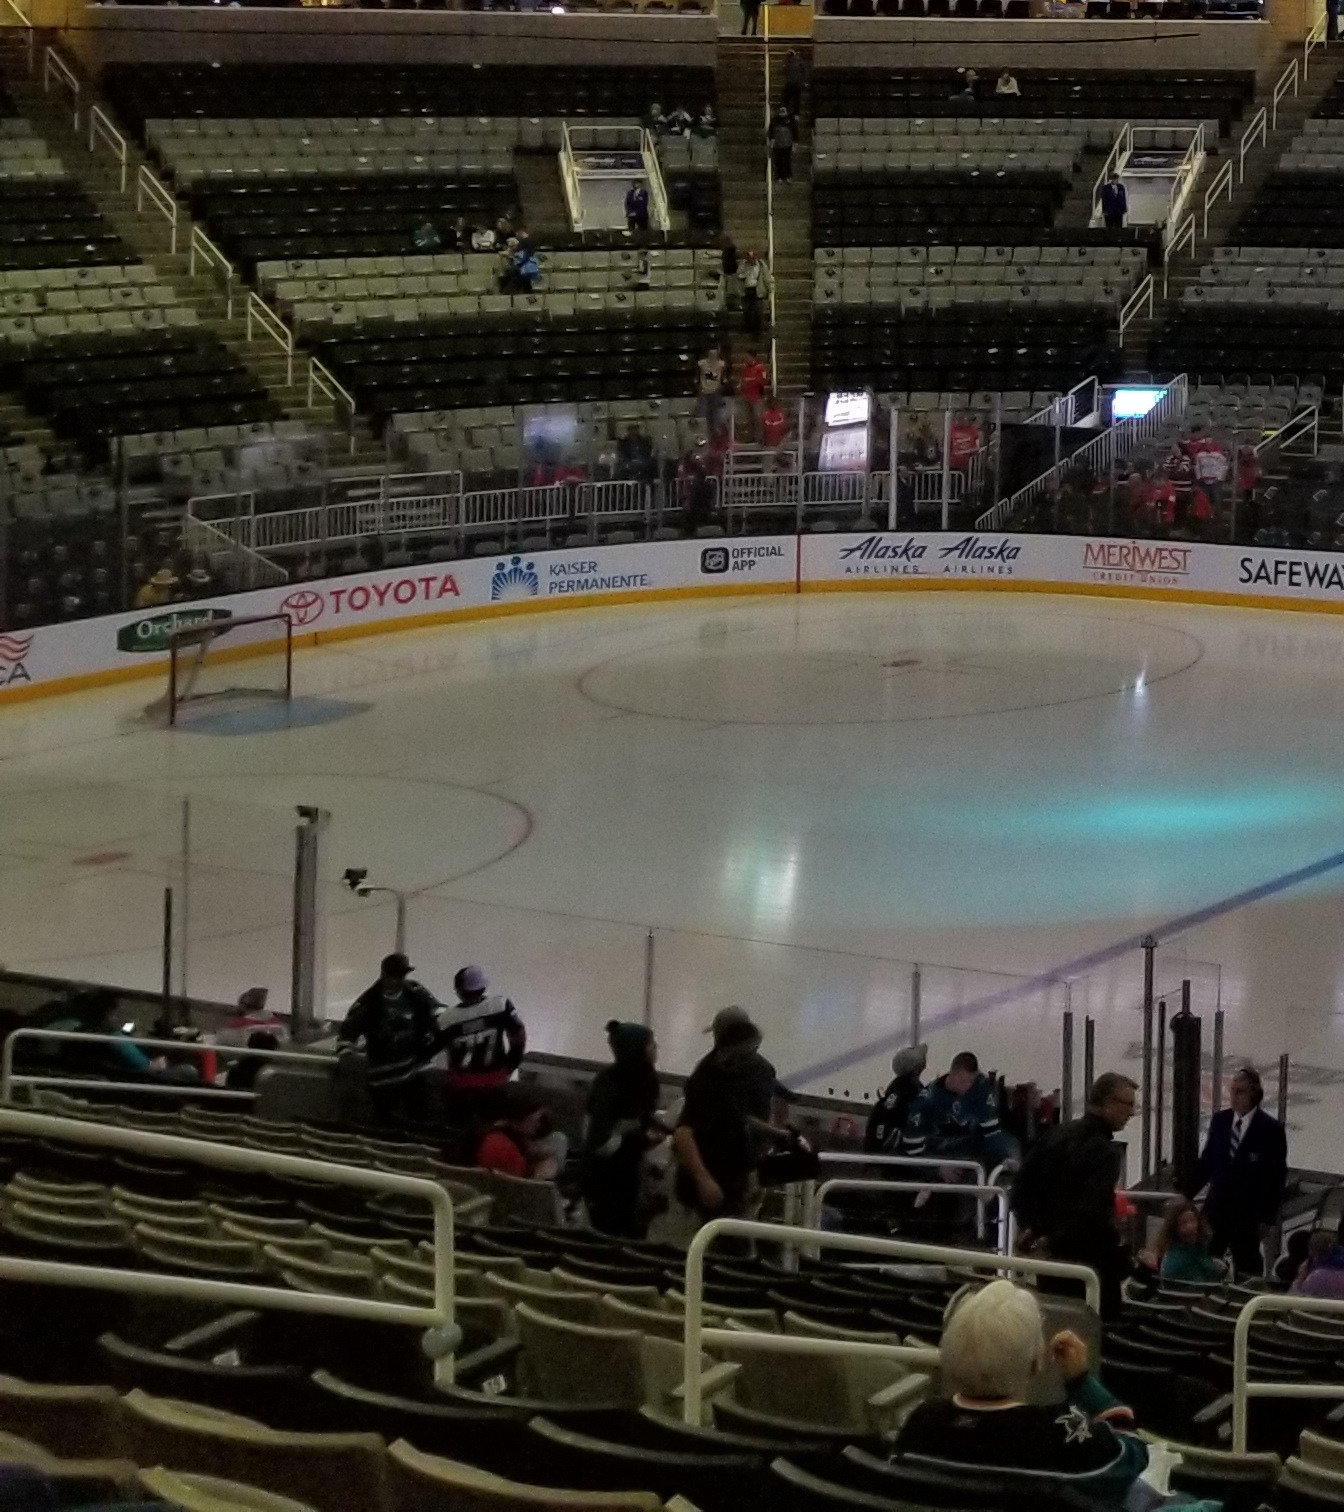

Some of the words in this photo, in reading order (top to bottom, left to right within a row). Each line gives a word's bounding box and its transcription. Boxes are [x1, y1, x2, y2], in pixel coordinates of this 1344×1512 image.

[731, 545, 785, 560] OFFICIAL
[839, 535, 929, 562] Alaska
[938, 535, 1022, 562] Alaska
[548, 560, 599, 578] KAISER
[731, 559, 757, 572] APP
[329, 574, 461, 614] TOYOTA
[548, 573, 648, 596] PERMANENTE
[453, 1028, 499, 1068] 77
